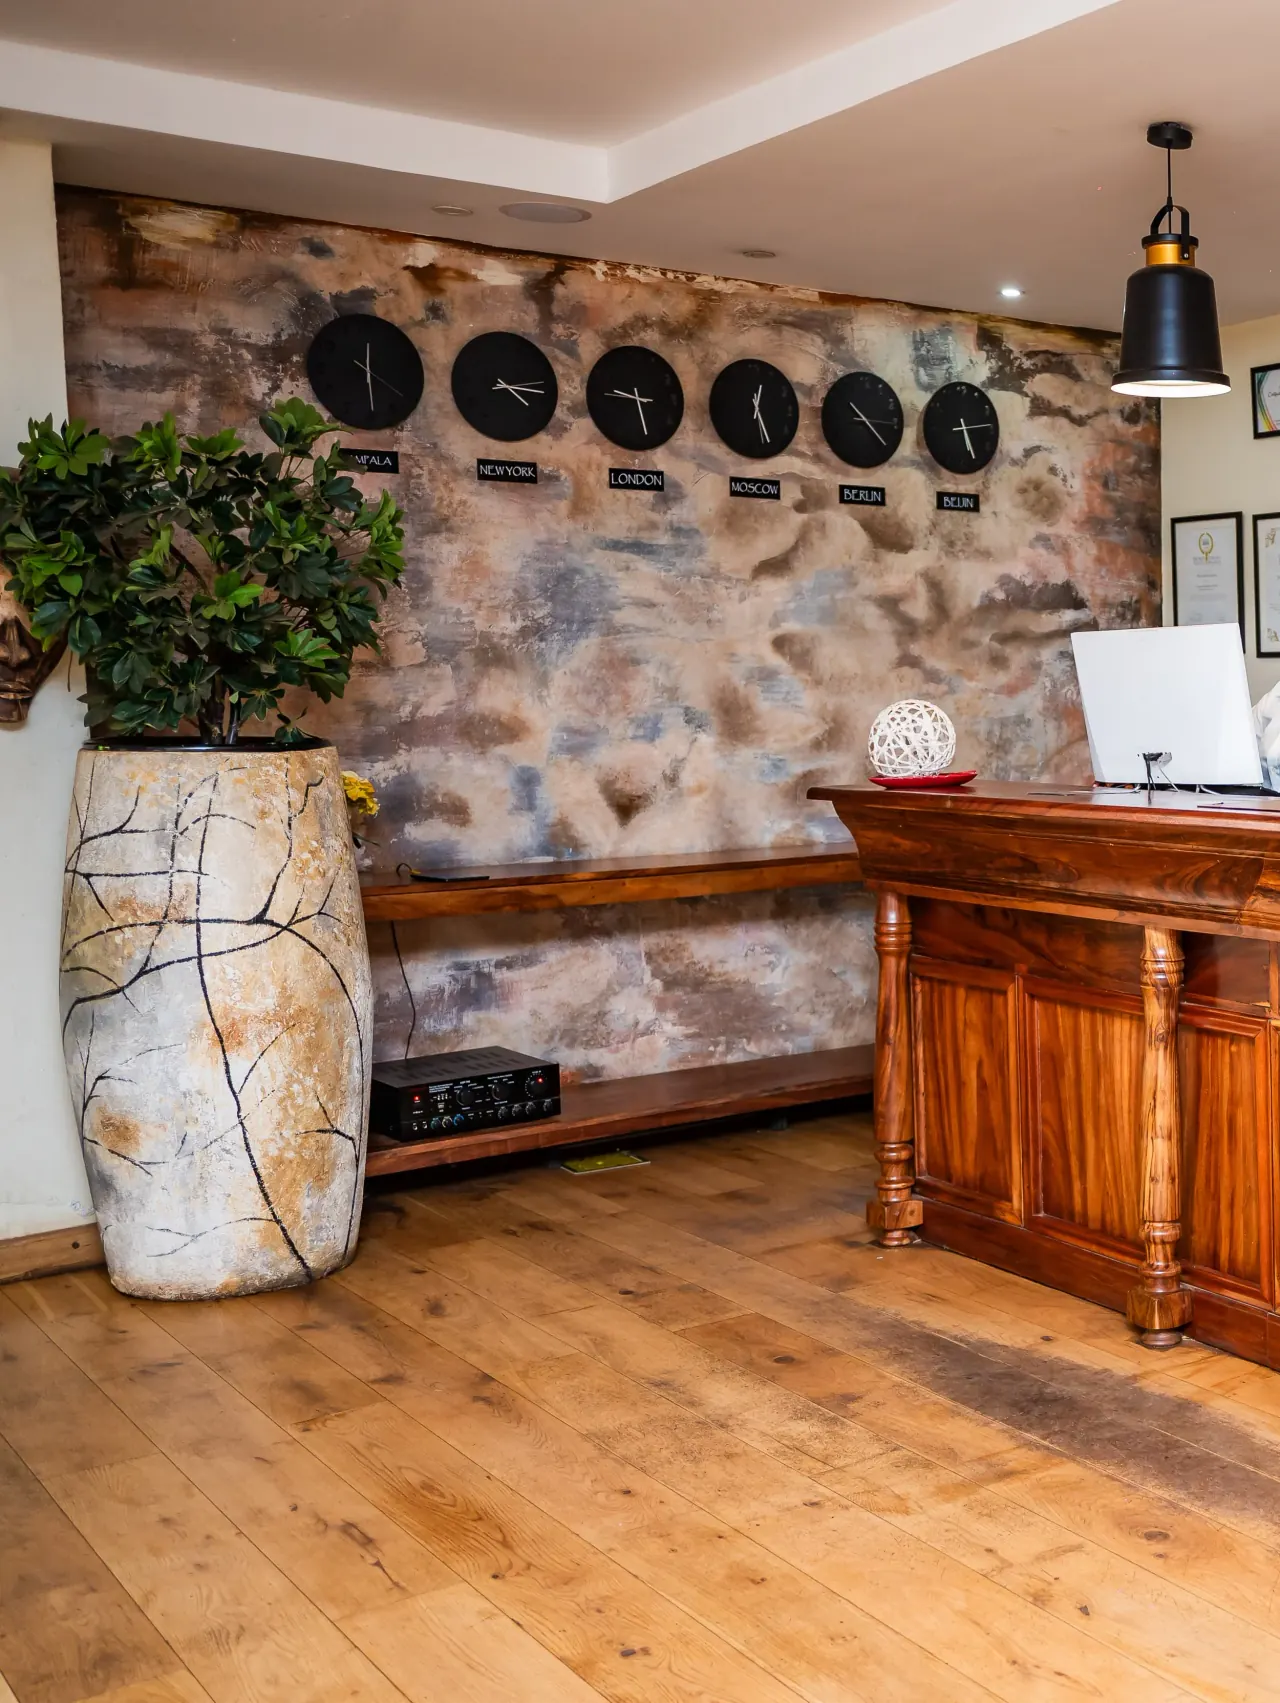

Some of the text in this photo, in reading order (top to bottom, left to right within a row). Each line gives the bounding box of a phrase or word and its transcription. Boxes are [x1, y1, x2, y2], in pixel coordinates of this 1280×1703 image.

[611, 472, 662, 486] LONDON
[731, 481, 778, 494] MOSCOW
[843, 488, 881, 502] BERLIN
